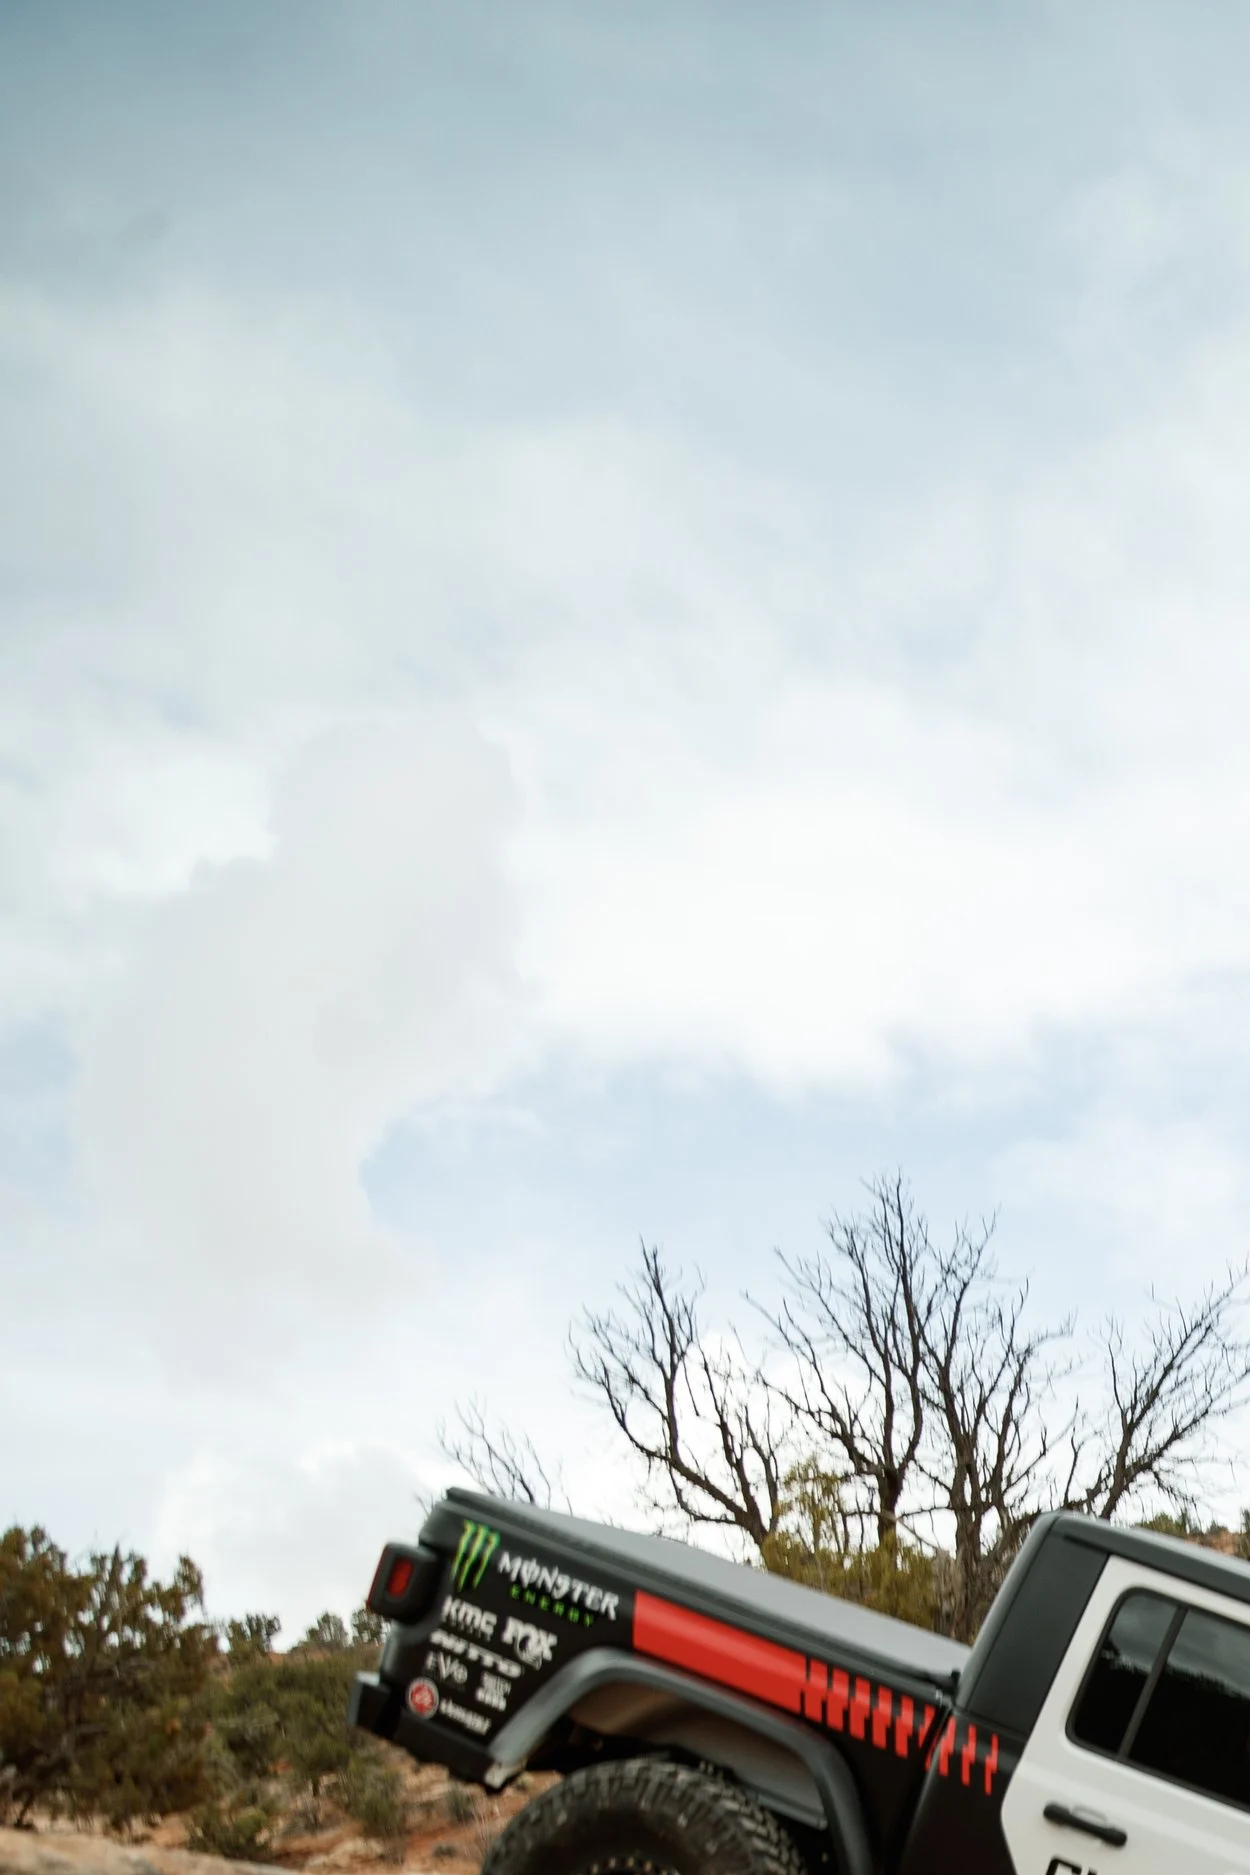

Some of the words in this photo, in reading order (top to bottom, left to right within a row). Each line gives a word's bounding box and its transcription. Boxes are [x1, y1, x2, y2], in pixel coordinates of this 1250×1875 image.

[498, 1551, 619, 1621] MONSTER
[510, 1585, 595, 1627] ENERGY
[430, 1629, 522, 1679] NITTO
[502, 1616, 558, 1670] FOX
